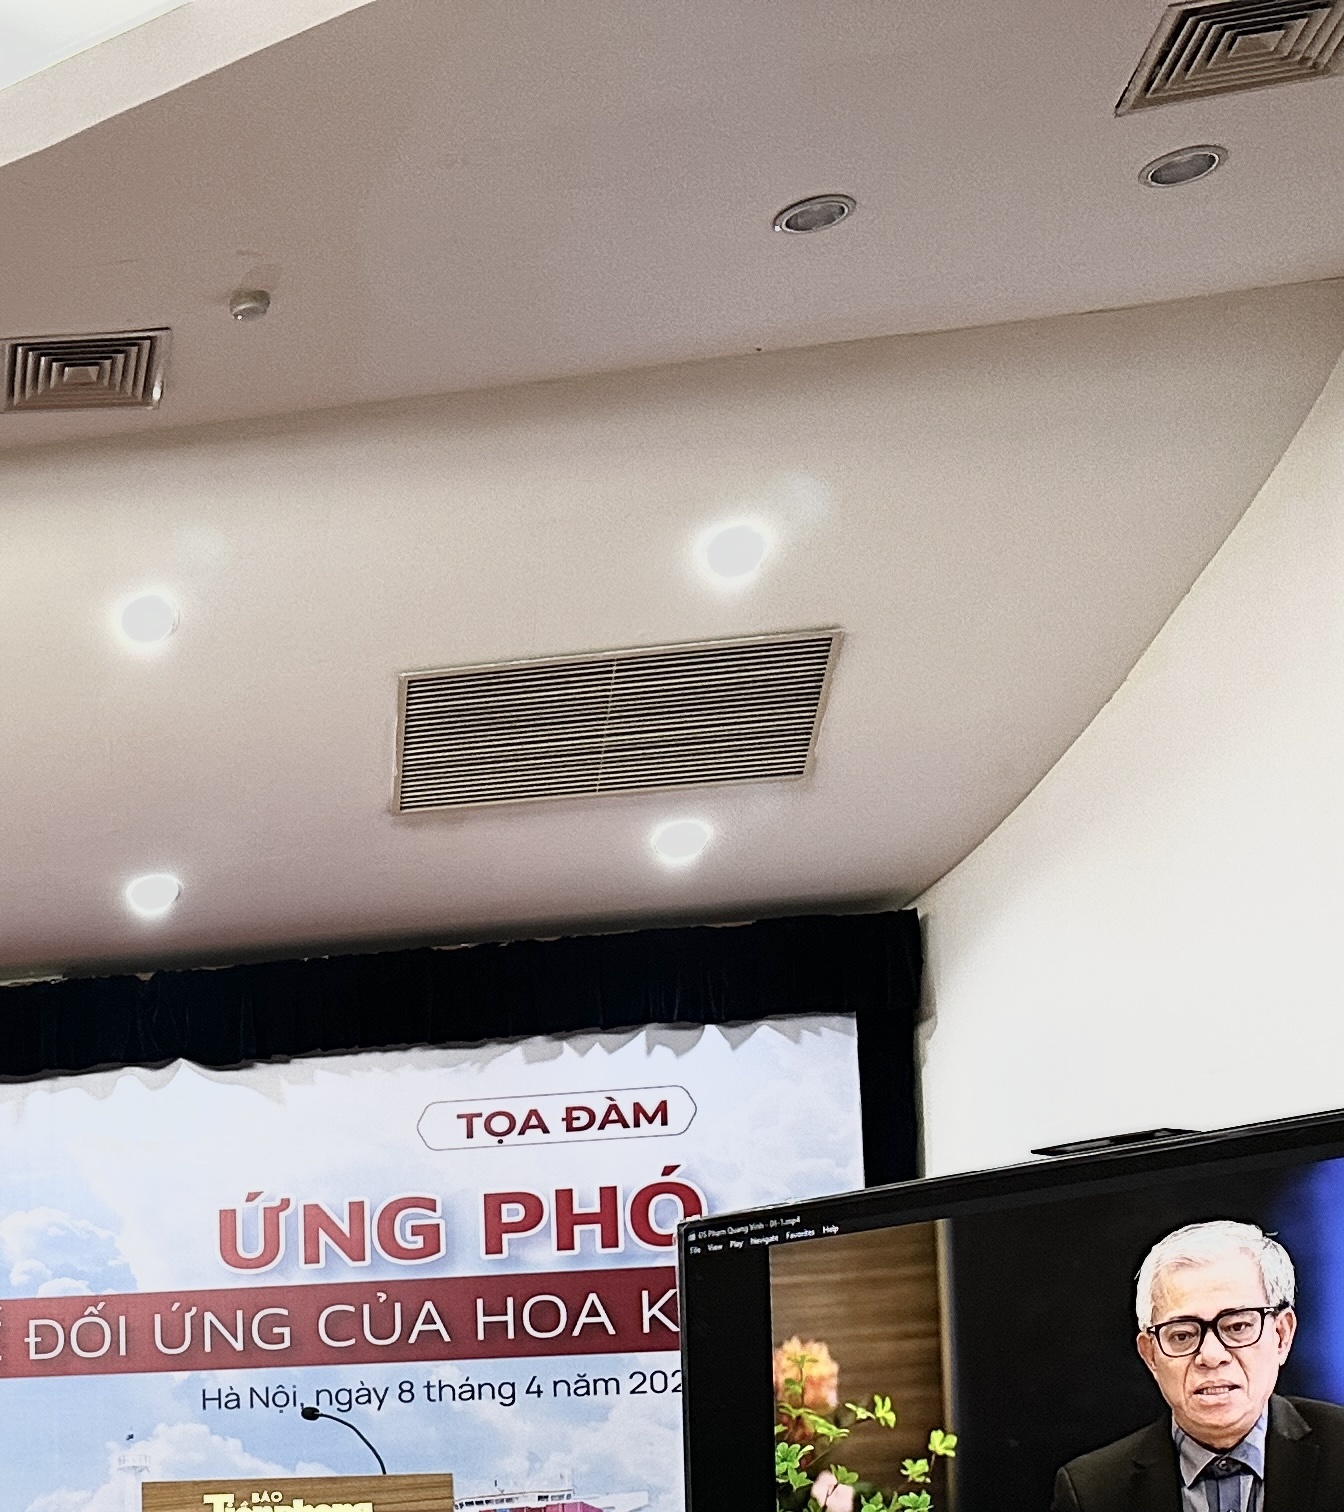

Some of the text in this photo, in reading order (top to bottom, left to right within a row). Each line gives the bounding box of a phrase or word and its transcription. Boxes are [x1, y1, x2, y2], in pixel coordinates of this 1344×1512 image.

[457, 1096, 669, 1145] TỌA ĐÀM
[218, 1165, 703, 1271] ỨNG PHÓ
[24, 1302, 127, 1361] ĐỐI
[153, 1302, 292, 1355] ỨNG
[317, 1292, 452, 1348] CỦA
[476, 1292, 616, 1341] HOA
[641, 1288, 680, 1333] K
[201, 1385, 241, 1411] Hà
[315, 1379, 390, 1413] ngày
[398, 1378, 415, 1403] 8
[423, 1375, 517, 1409] tháng
[525, 1374, 544, 1400] 4
[552, 1371, 621, 1398] năm
[628, 1368, 682, 1395] 202
[251, 1490, 283, 1504] BÁO
